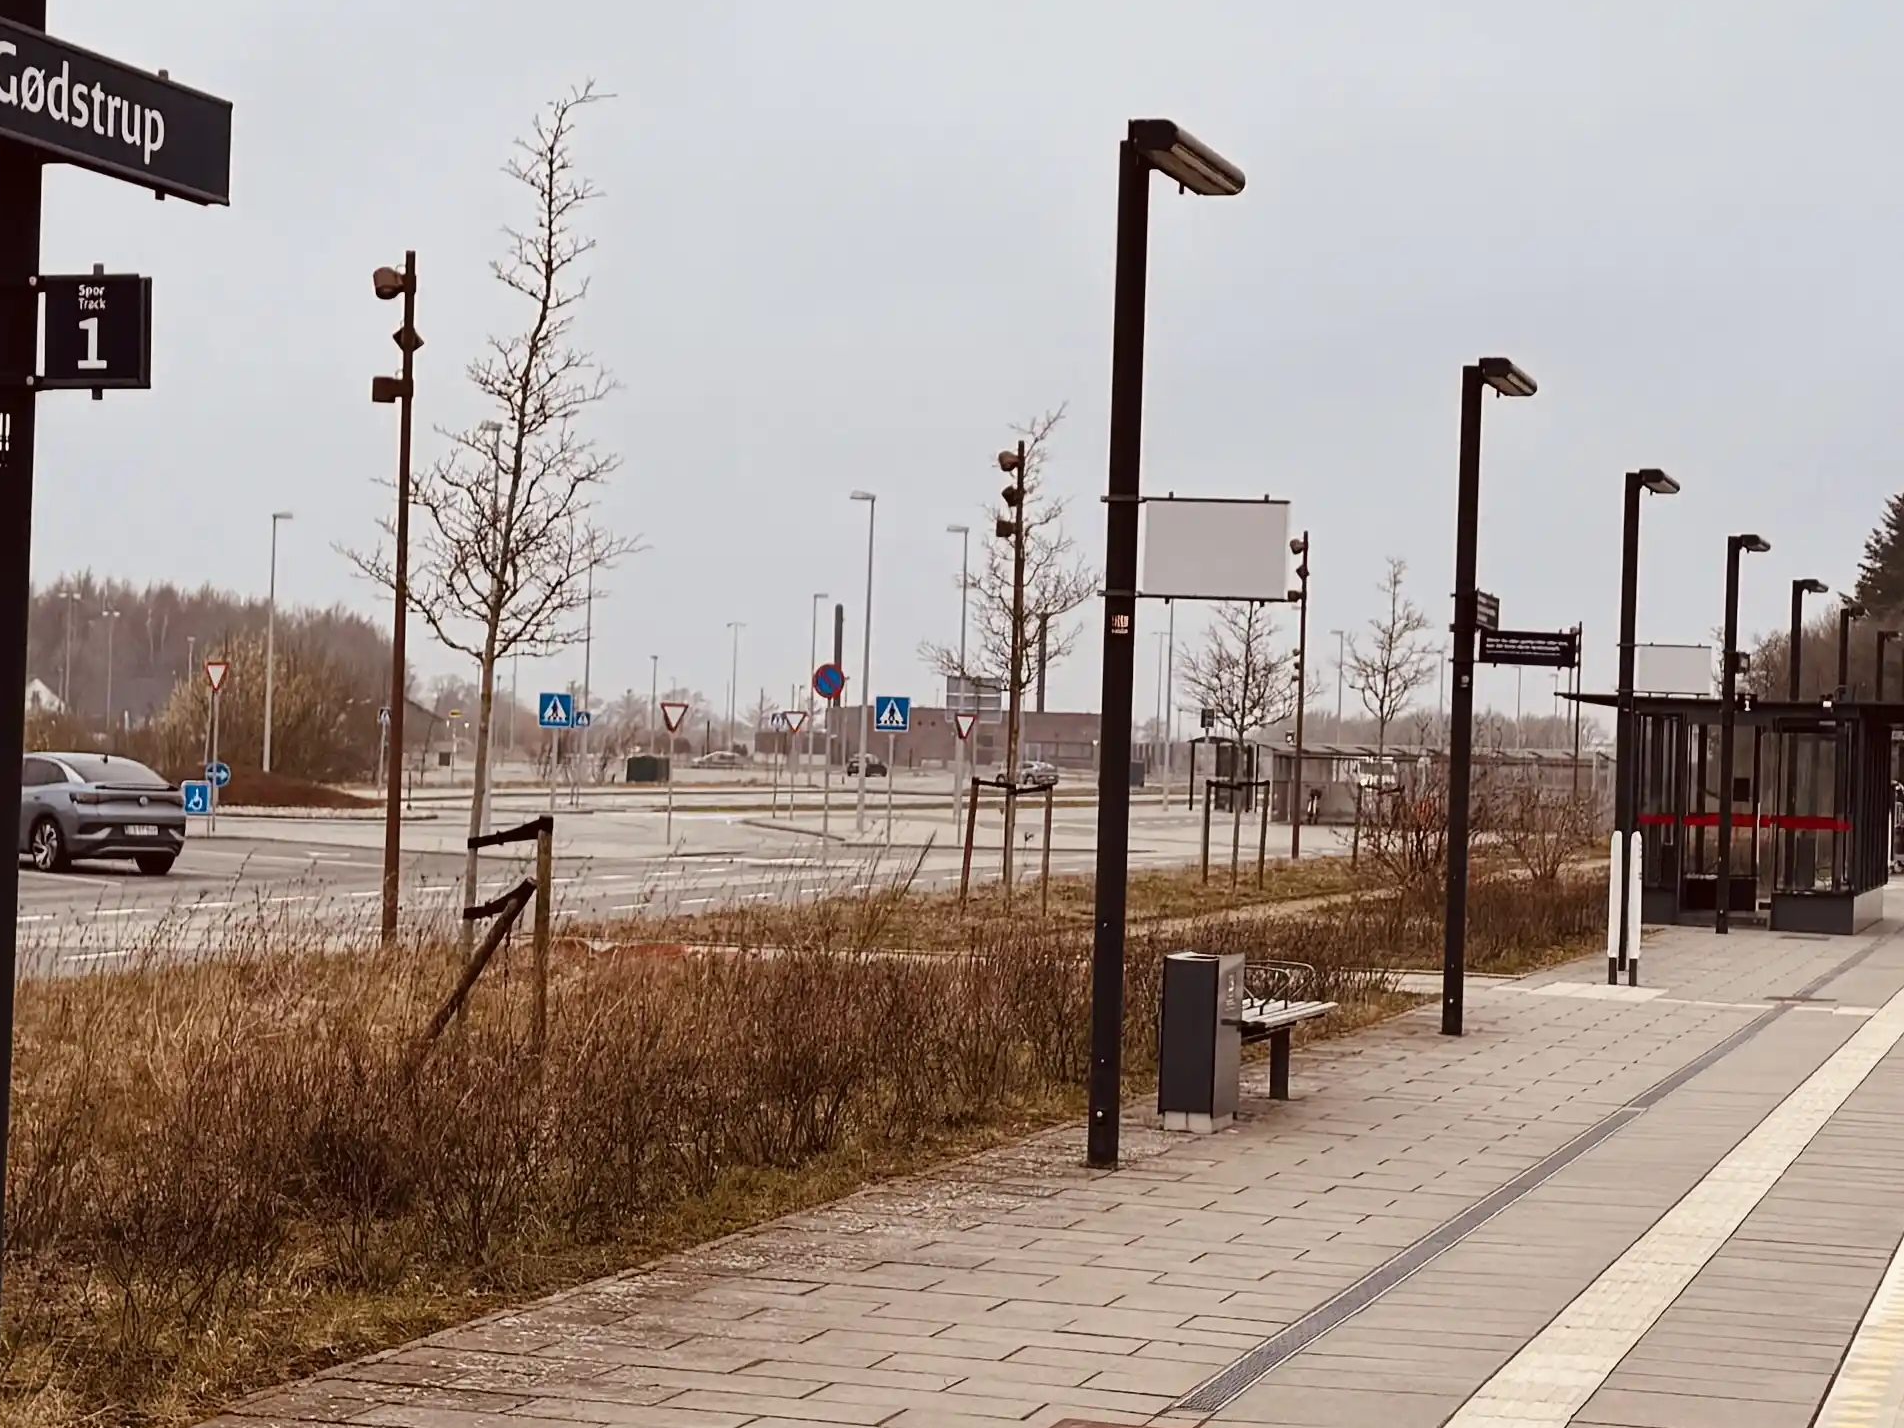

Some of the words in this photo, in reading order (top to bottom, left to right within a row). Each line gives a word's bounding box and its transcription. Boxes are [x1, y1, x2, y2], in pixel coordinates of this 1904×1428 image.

[78, 283, 105, 298] Spor
[78, 297, 106, 310] Track
[78, 317, 107, 369] 1
